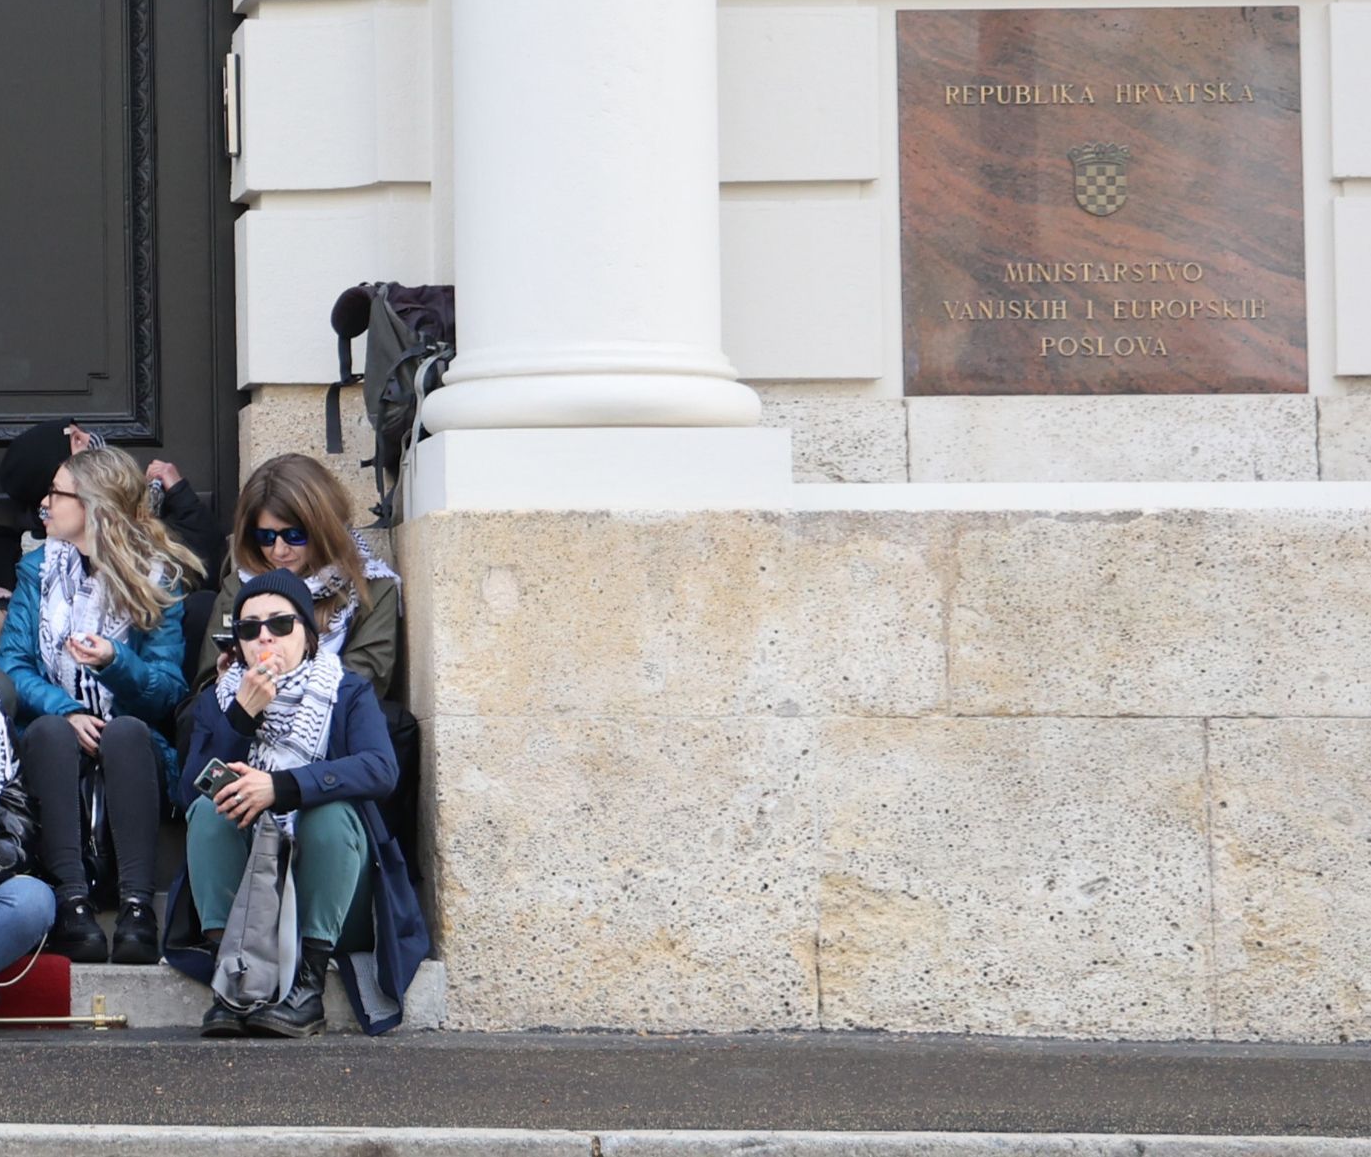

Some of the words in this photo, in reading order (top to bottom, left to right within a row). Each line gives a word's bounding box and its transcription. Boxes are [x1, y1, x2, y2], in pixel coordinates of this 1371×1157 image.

[945, 84, 1095, 106] REPUBLIKA
[1115, 82, 1255, 104] HRVATSKA
[1003, 262, 1203, 283] MINISTARSTVO
[943, 300, 1067, 320] VANJSKIH
[1086, 300, 1094, 319] I
[1113, 298, 1267, 320] EUROPSKIH
[1039, 336, 1169, 357] POSLOVA
